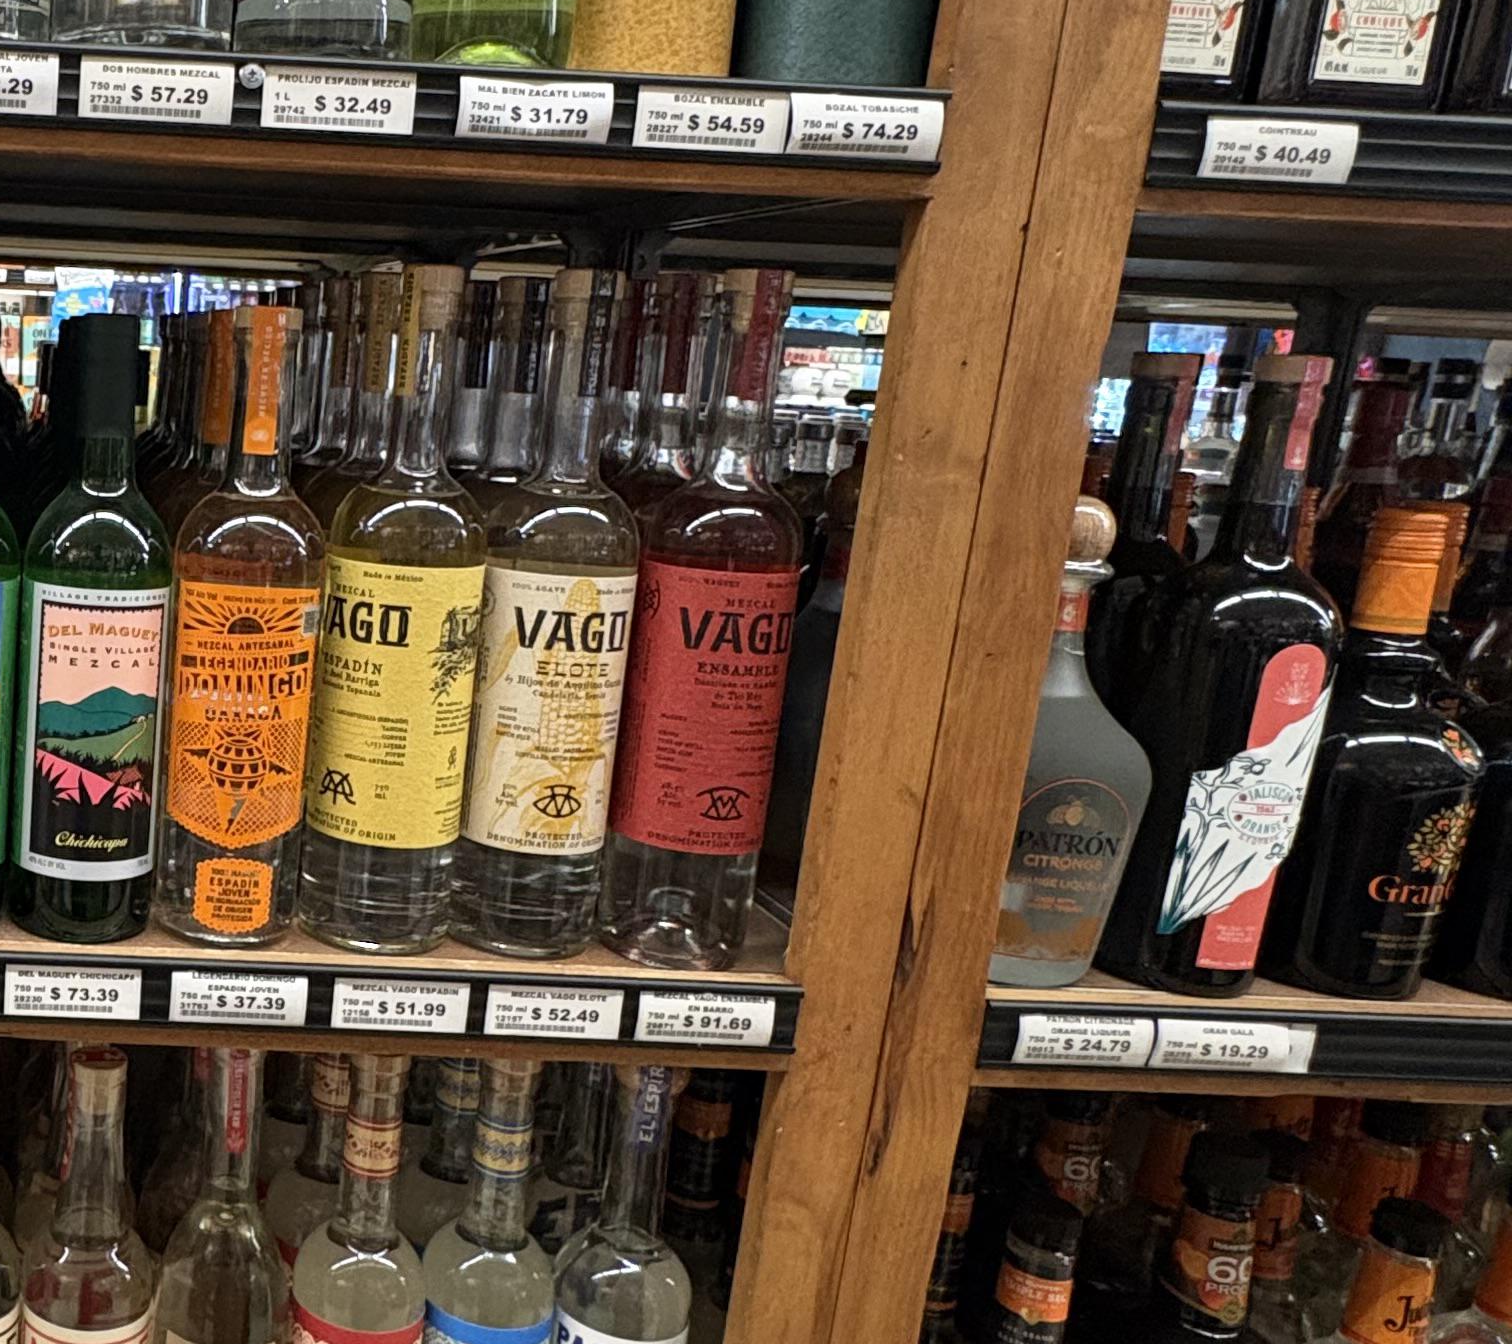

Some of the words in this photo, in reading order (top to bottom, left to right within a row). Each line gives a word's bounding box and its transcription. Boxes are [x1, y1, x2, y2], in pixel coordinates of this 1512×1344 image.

[102, 64, 122, 76] DOS
[126, 65, 180, 78] HOMBRES
[183, 68, 220, 80] MEZCAL
[314, 94, 326, 114] $
[334, 96, 392, 115] 32.49
[842, 123, 854, 139] $
[862, 123, 918, 141] 74.29
[1255, 145, 1266, 161] $
[1273, 145, 1331, 166] 40.49
[47, 625, 82, 639] DEL
[88, 624, 159, 642] MAGUEY
[50, 642, 96, 654] SINGLE
[48, 655, 155, 669] MEZCAL
[535, 661, 610, 677] ELOTE
[378, 1000, 388, 1016] $
[395, 1002, 446, 1017] 51.99
[1063, 1037, 1073, 1052] $
[1080, 1038, 1131, 1053] 24.79
